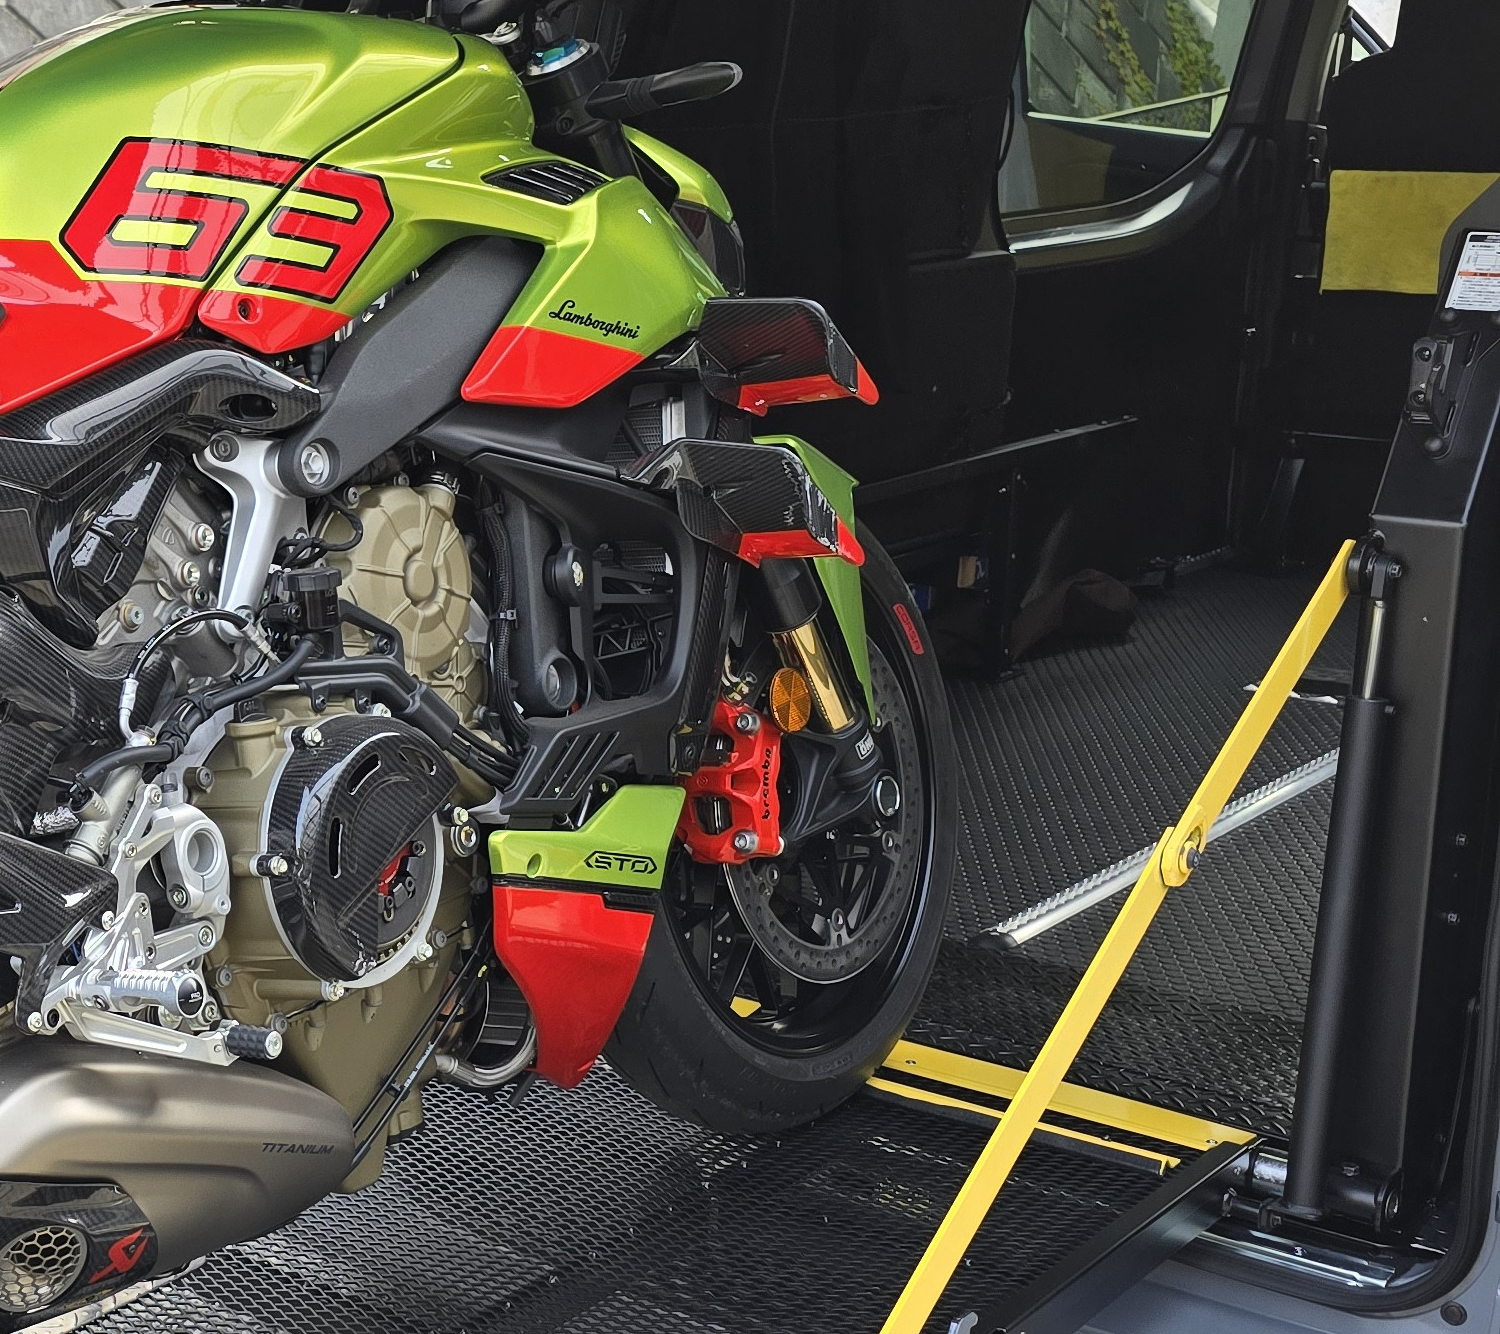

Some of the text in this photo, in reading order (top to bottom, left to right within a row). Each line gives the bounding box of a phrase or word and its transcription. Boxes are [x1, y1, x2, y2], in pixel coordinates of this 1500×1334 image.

[59, 136, 395, 306] 63
[548, 298, 641, 341] Lamborghini
[895, 604, 923, 652] CORSA
[761, 747, 773, 821] brembo
[261, 1140, 336, 1156] TITANIUM
